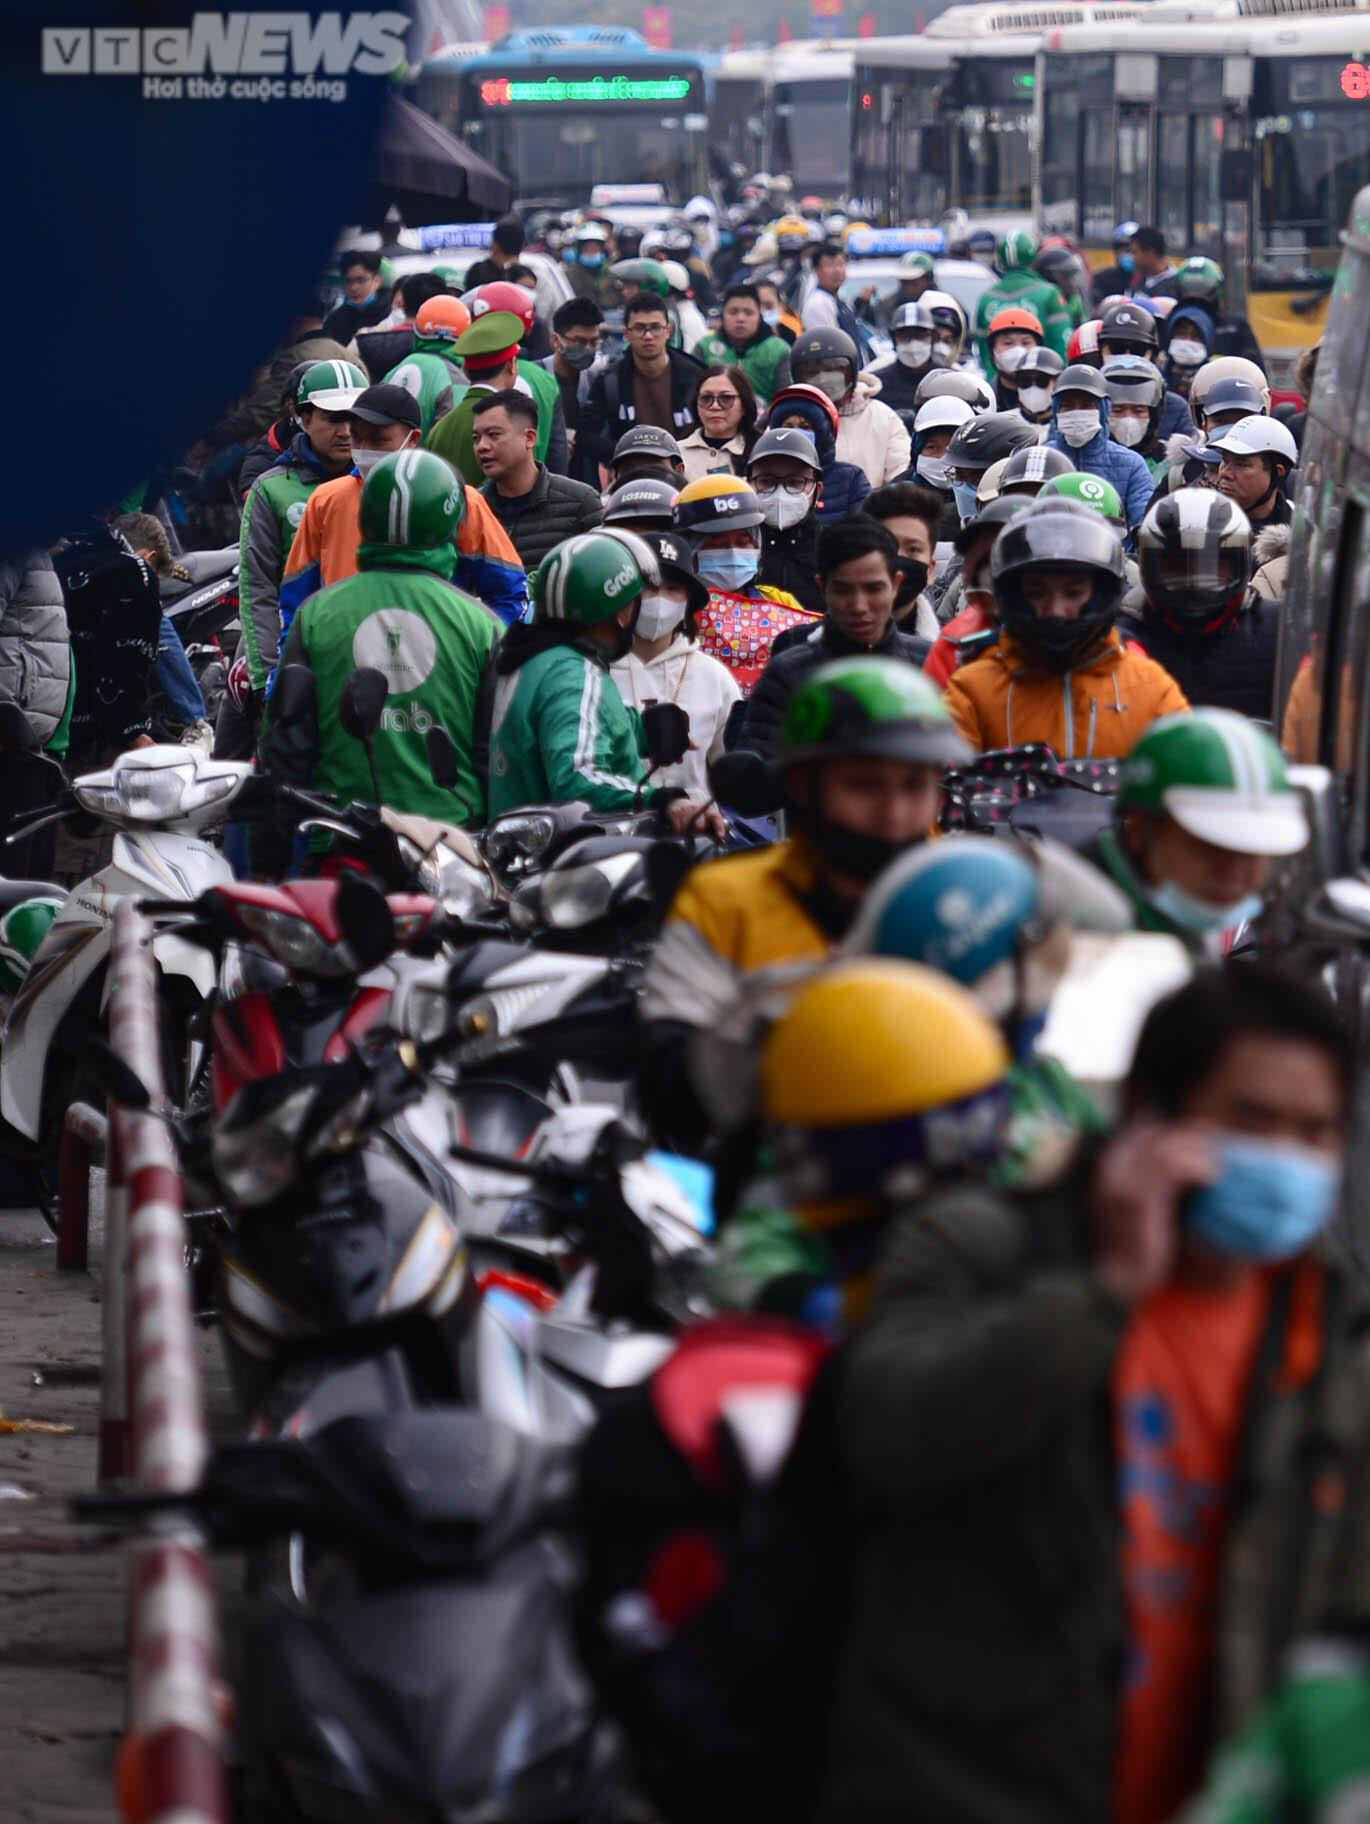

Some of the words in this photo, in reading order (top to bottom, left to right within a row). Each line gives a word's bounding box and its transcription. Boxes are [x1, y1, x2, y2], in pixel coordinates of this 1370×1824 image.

[659, 539, 678, 561] LA
[603, 562, 638, 598] Grab
[379, 700, 433, 735] rab
